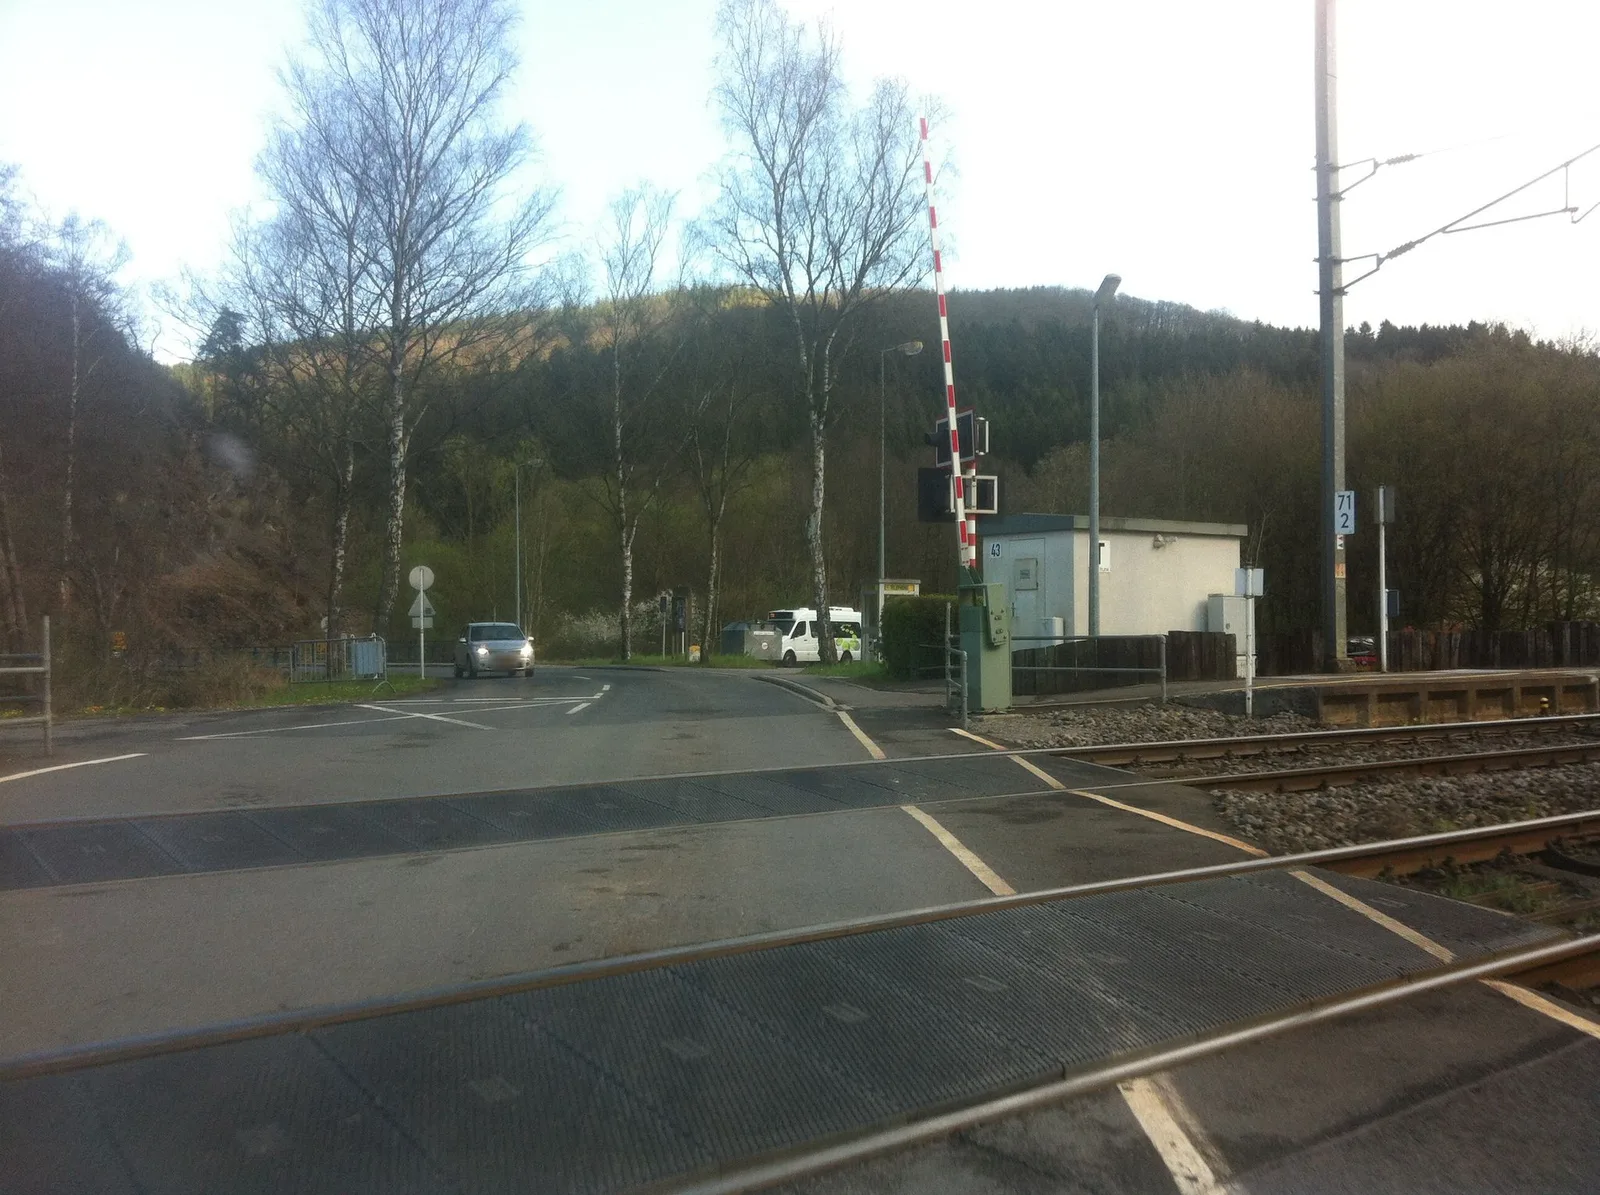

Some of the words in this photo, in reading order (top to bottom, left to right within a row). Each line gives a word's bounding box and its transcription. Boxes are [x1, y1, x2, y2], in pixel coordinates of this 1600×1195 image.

[1338, 494, 1351, 511] 71
[1340, 513, 1349, 529] 2
[991, 543, 1001, 557] 43
